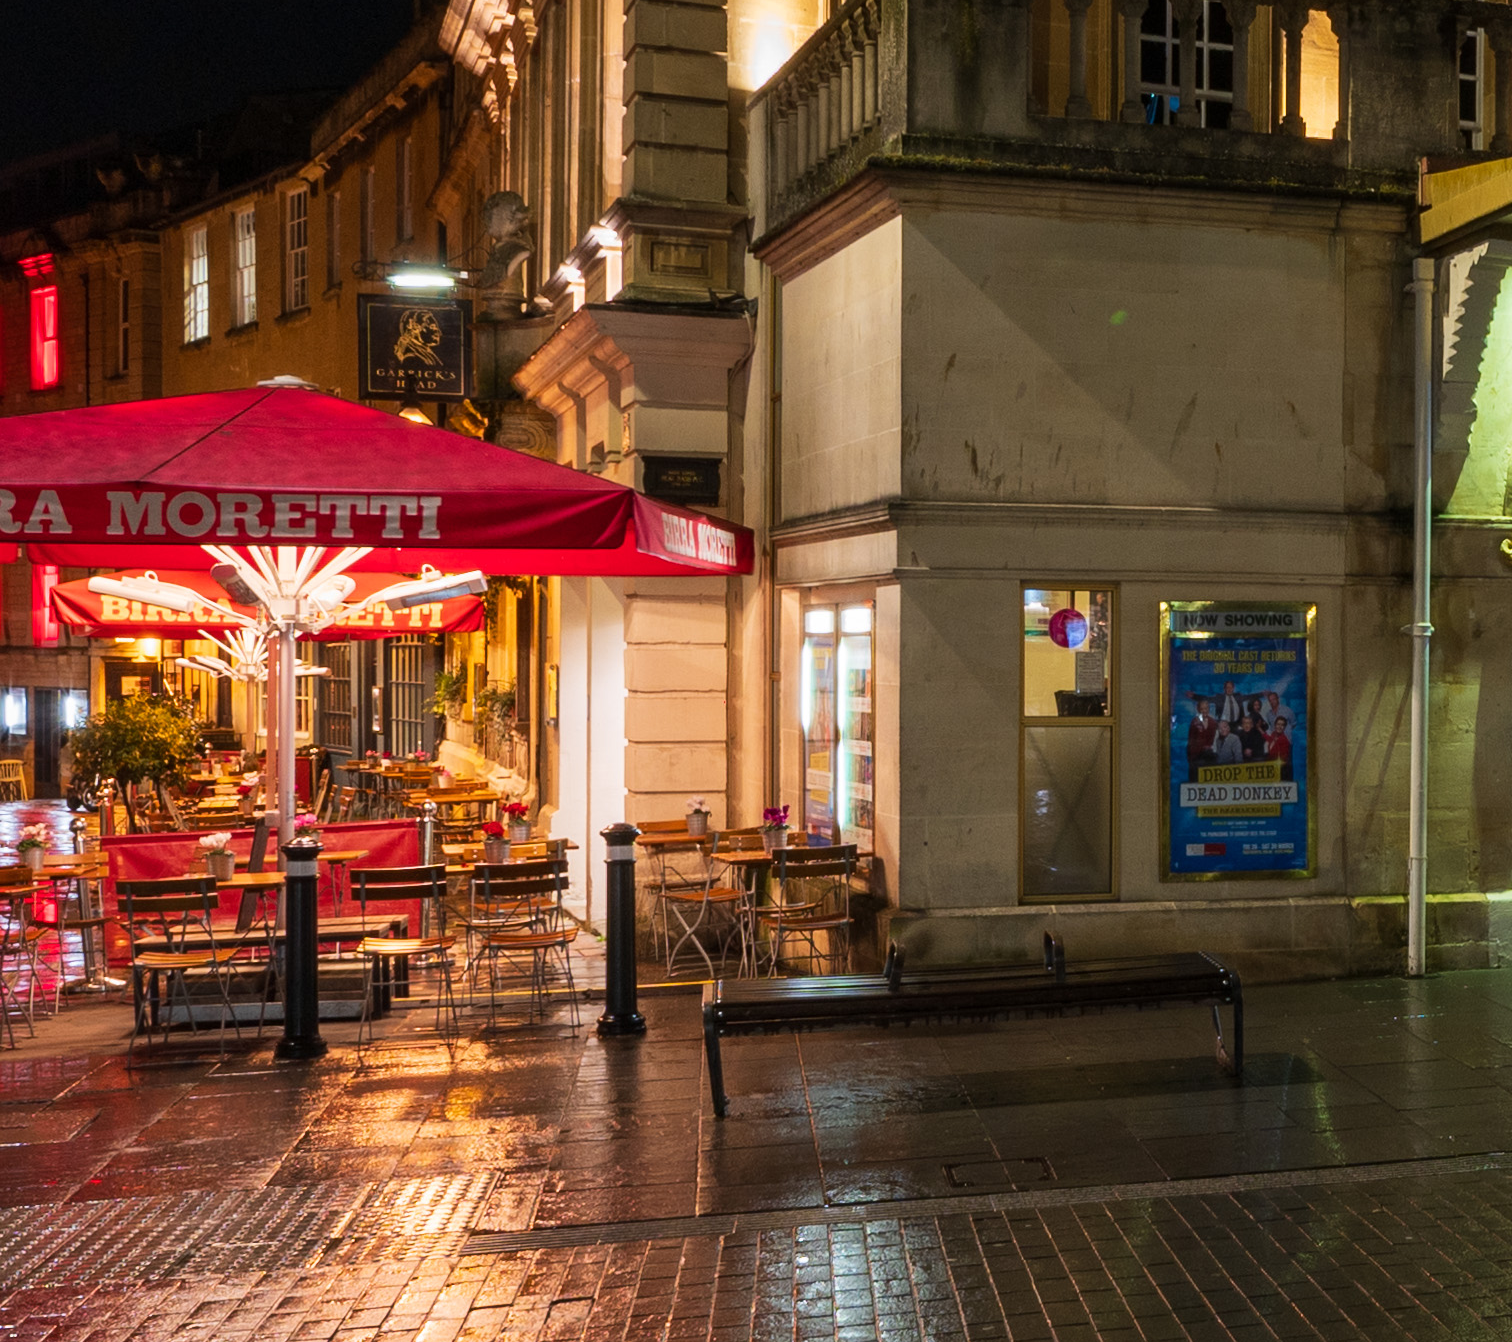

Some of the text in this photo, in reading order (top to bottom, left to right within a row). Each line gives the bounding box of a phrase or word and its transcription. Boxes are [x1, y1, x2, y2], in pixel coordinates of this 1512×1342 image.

[396, 379, 437, 389] HAD
[106, 491, 443, 540] MORETTI
[697, 522, 737, 567] MORETTI
[1183, 614, 1293, 627] NOW SHOWING
[1182, 650, 1296, 662] THE ORIGINAL CAST RETURNS
[1214, 663, 1266, 674] 30 YEARS ON
[1203, 765, 1276, 782] DROP THE
[1187, 786, 1293, 802] DEAD DONKEY
